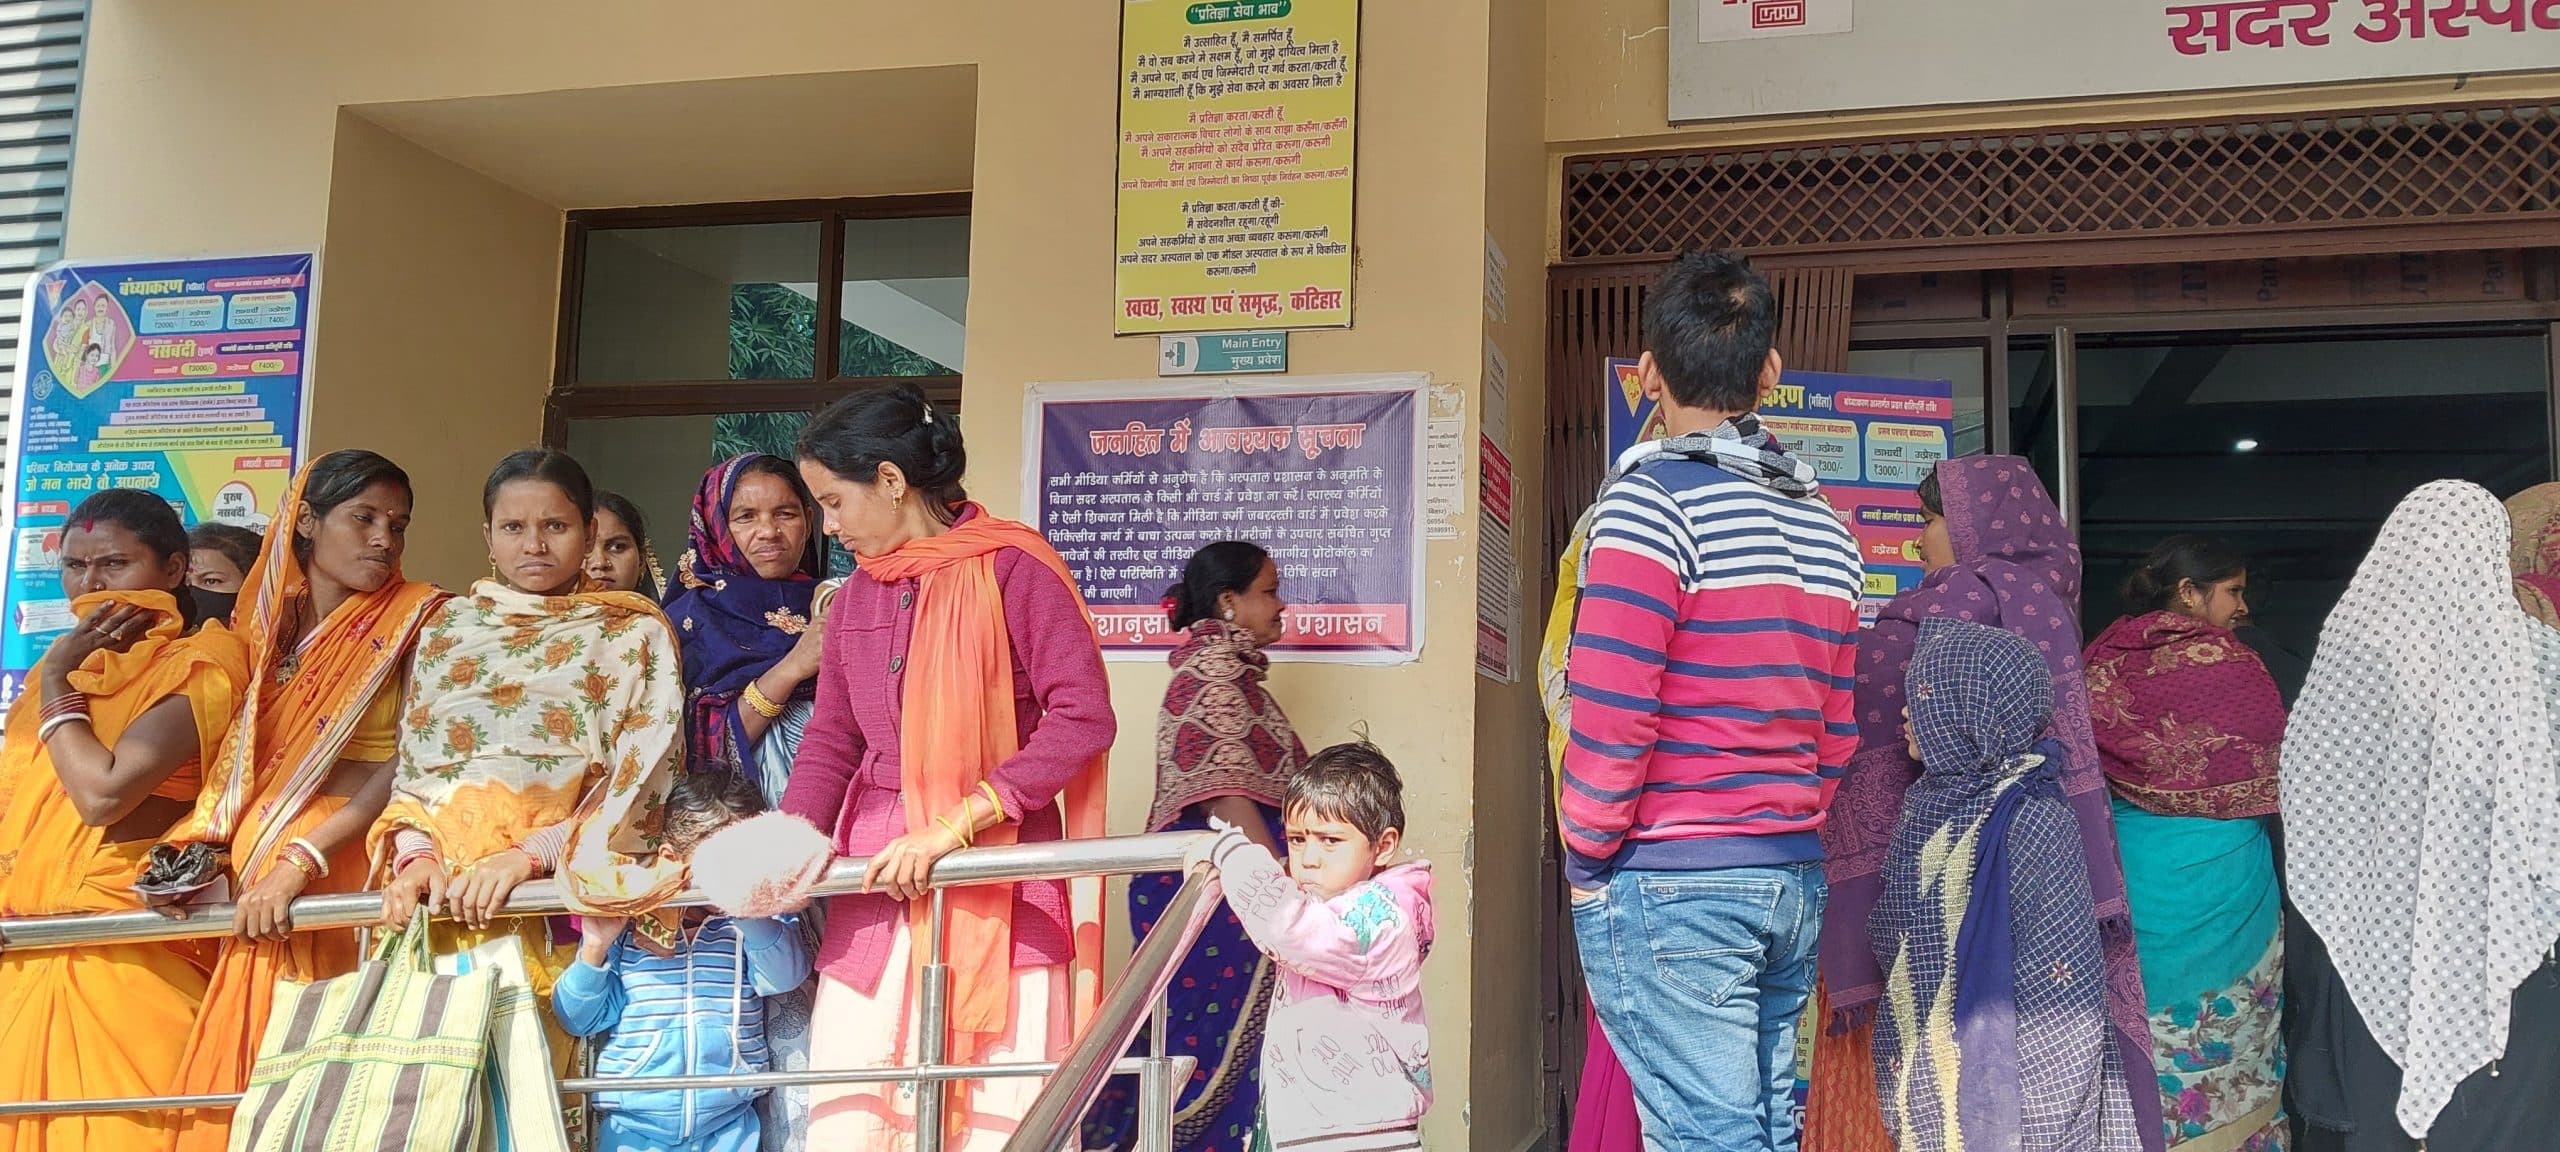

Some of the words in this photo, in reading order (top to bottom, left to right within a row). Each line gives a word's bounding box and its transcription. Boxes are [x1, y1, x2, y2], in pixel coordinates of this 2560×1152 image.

[1233, 4, 1254, 17] सेवा
[2166, 0, 2339, 55] सदर
[1194, 34, 1227, 47] उत्साहित
[1253, 29, 1283, 43] समर्पित
[1144, 86, 1184, 99] भाग्यशाली
[1195, 84, 1206, 96] कि
[1209, 84, 1223, 98] मुझे
[1227, 81, 1242, 93] सेवा
[1246, 78, 1266, 92] करने
[1269, 80, 1279, 90] का
[1283, 78, 1309, 88] अवसर
[1313, 75, 1333, 87] मिला
[1335, 73, 1342, 86] है
[1199, 111, 1223, 123] प्रतिज्ञा
[1226, 107, 1274, 121] करता/करती
[1192, 201, 1213, 213] प्रतिज्ञा
[1216, 199, 1260, 211] करता/करती
[1197, 215, 1235, 229] संवेदनशील
[1120, 252, 1138, 264] अपने
[1141, 253, 1157, 263] सदर
[1160, 252, 1191, 262] अस्पताल
[1195, 250, 1204, 261] को
[1207, 252, 1219, 261] एक
[1246, 249, 1278, 259] अस्पताल
[1281, 245, 1288, 256] के
[1291, 247, 1303, 256] रूप
[1317, 243, 1346, 255] विकसित
[1126, 298, 1163, 320] स्वच्छ,
[1212, 290, 1234, 313] एवं
[1239, 294, 1283, 318] समृद्ध,
[1291, 287, 1342, 310] कटिहार
[149, 340, 196, 359] नसबंदी
[1222, 338, 1248, 348] Main
[1252, 338, 1281, 349] Entry
[1231, 355, 1253, 369] मुख्य
[1258, 353, 1281, 365] प्रवेश
[1809, 394, 1832, 410] (महिला)
[1090, 422, 1164, 459] जनहित
[1170, 419, 1191, 454] में
[1200, 425, 1291, 458] आवश्यक
[1298, 423, 1366, 459] सूचना
[1816, 443, 1844, 453] उत्प्रेरक
[1874, 448, 1902, 457] लाभार्थी
[1915, 450, 1941, 460] उत्प्रेरक
[91, 460, 100, 471] के
[1818, 460, 1843, 472] ₹300/-
[1874, 466, 1903, 476] ₹3000/-
[26, 478, 36, 490] जो
[42, 479, 61, 490] मन
[1050, 473, 1071, 487] सभी
[1075, 472, 1107, 486] मीडिया
[1112, 471, 1144, 486] कर्मियों
[1149, 472, 1159, 485] से
[1163, 471, 1195, 488] अनुरोध
[1199, 471, 1208, 484] है
[1211, 469, 1224, 483] कि
[1228, 471, 1269, 483] अस्पताल
[1274, 470, 1312, 483] प्रशासन
[1317, 468, 1326, 481] के
[1330, 467, 1369, 483] अनुमति
[1373, 467, 1383, 479] के
[217, 507, 244, 517] नसबंदी
[1049, 511, 1058, 523] से
[1062, 510, 1080, 523] ऐसी
[1085, 509, 1124, 523] शिकायत
[1129, 509, 1152, 522] मिली
[1156, 509, 1164, 522] है
[1166, 509, 1180, 522] कि
[1183, 509, 1218, 522] मीडिया
[1222, 506, 1242, 521] कर्मी
[1248, 508, 1293, 521] जबरदस्ती
[1298, 505, 1316, 520] वार्ड
[1320, 505, 1330, 520] में
[1335, 508, 1359, 520] प्रवेश
[1364, 506, 1388, 519] करके
[1048, 529, 1096, 543] चिकित्सीय
[1100, 528, 1120, 541] कार्य
[1125, 529, 1135, 541] में
[1138, 529, 1159, 541] बाधा
[1165, 529, 1195, 542] उत्पन्न
[1200, 529, 1221, 541] करते
[1241, 528, 1272, 541] मरीजों
[1277, 528, 1287, 540] के
[1290, 528, 1322, 541] उपचार
[1327, 525, 1365, 540] संबंधित
[1370, 526, 1391, 543] गुप्त
[1093, 547, 1105, 561] की
[1109, 547, 1139, 561] तस्वीर
[1143, 546, 1157, 561] एवं
[1313, 546, 1356, 561] प्रोटोकॉल
[1360, 547, 1374, 560] का
[1872, 545, 1898, 554] उत्प्रेरक
[1101, 567, 1116, 580] ऐसे
[1120, 566, 1165, 579] परिस्थिति
[1169, 566, 1178, 579] में
[1284, 565, 1307, 578] विधि
[1312, 566, 1336, 578] संवत
[1084, 586, 1096, 598] की
[1297, 613, 1385, 637] प्रशासन
